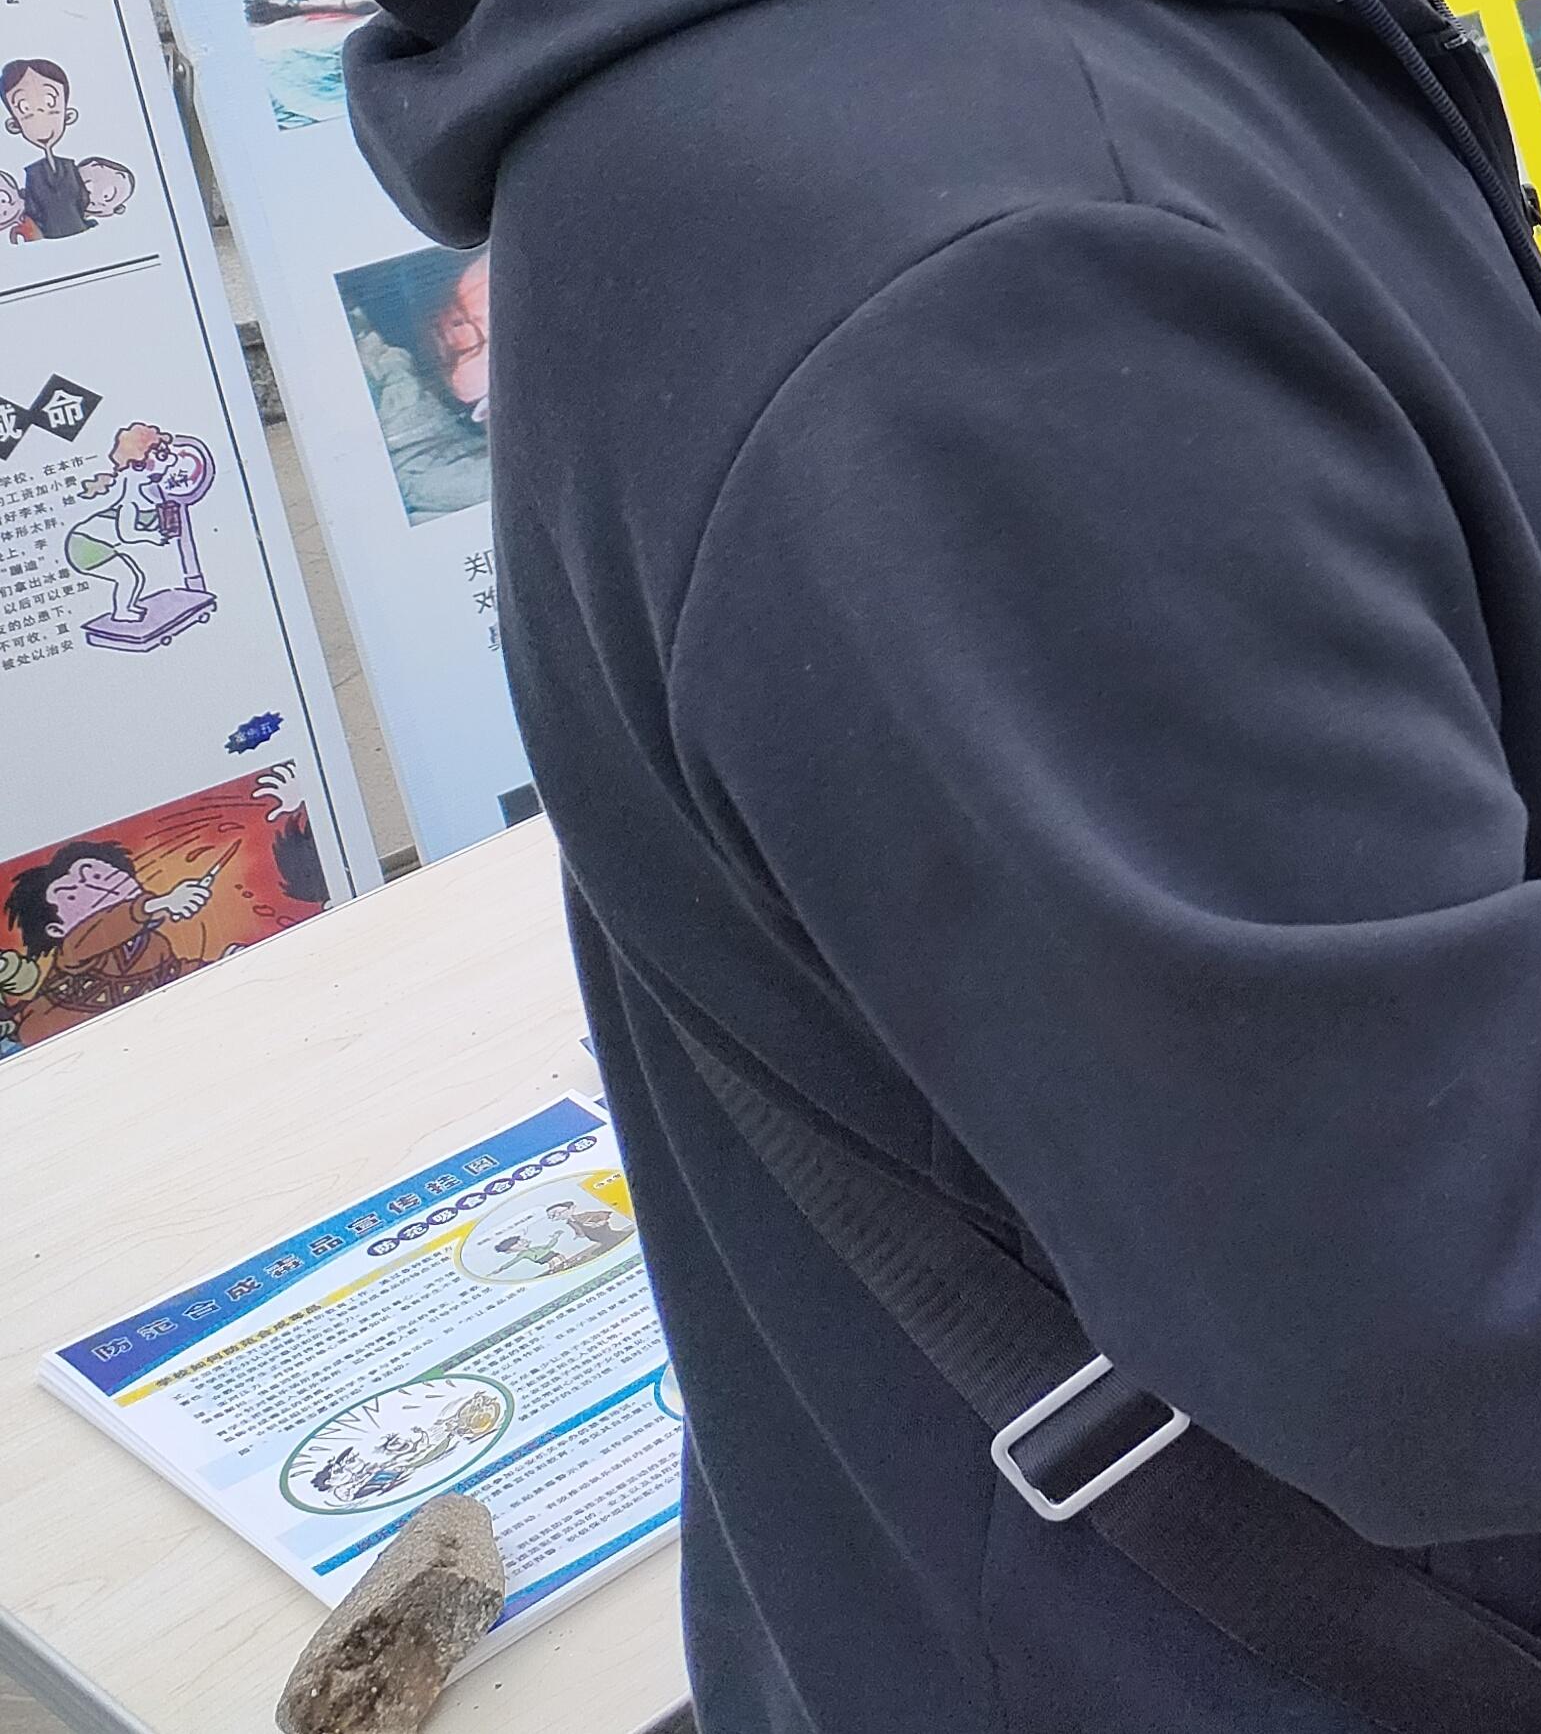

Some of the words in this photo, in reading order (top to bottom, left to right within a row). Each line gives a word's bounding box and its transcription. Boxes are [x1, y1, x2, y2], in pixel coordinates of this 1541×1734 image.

[0, 493, 76, 528] 好李某，她
[4, 580, 90, 613] 以后可以更加
[370, 1136, 597, 1256] 防范吸食合成毒品
[92, 1154, 500, 1364] 防范合成毒品宣传挂图
